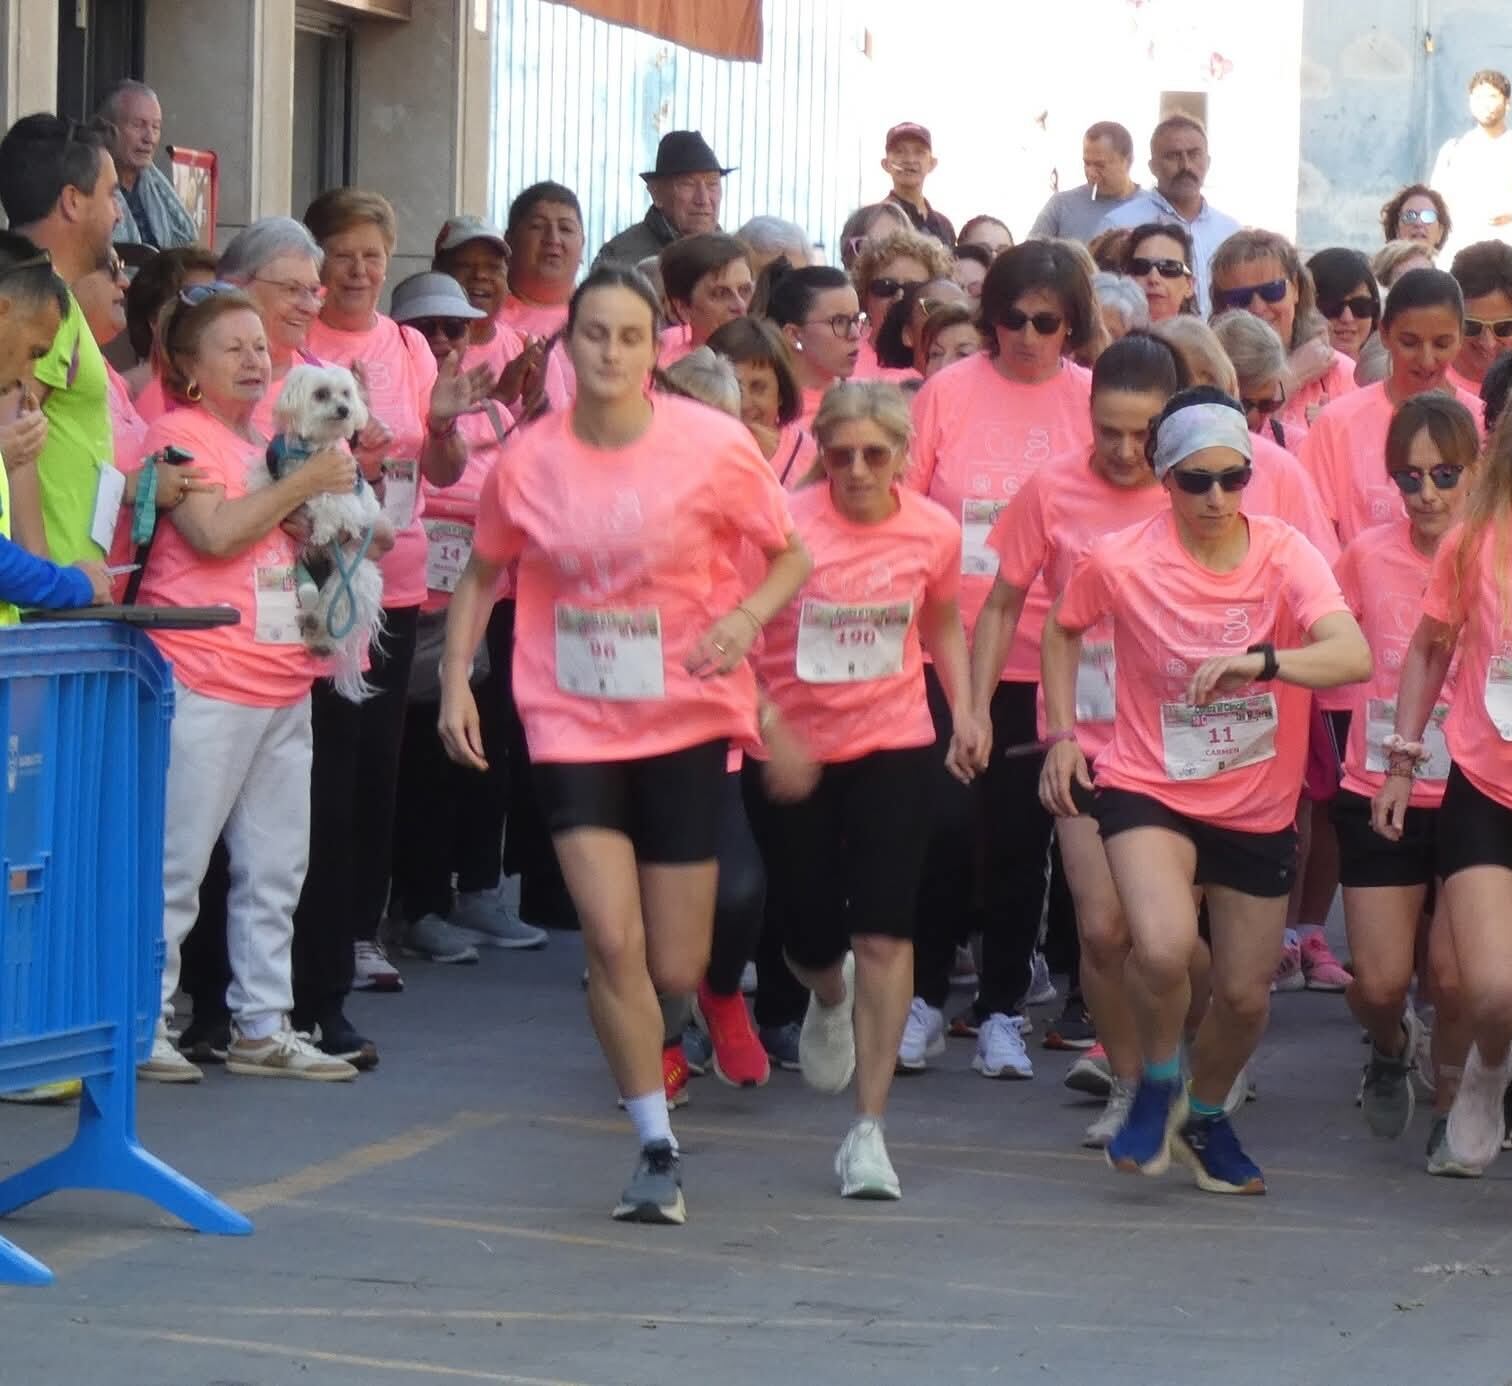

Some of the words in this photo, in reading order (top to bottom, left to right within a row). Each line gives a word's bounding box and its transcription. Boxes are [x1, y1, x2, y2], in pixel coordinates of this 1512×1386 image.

[440, 545, 460, 561] 14
[1208, 726, 1234, 743] 11
[1205, 747, 1240, 756] CARMEN
